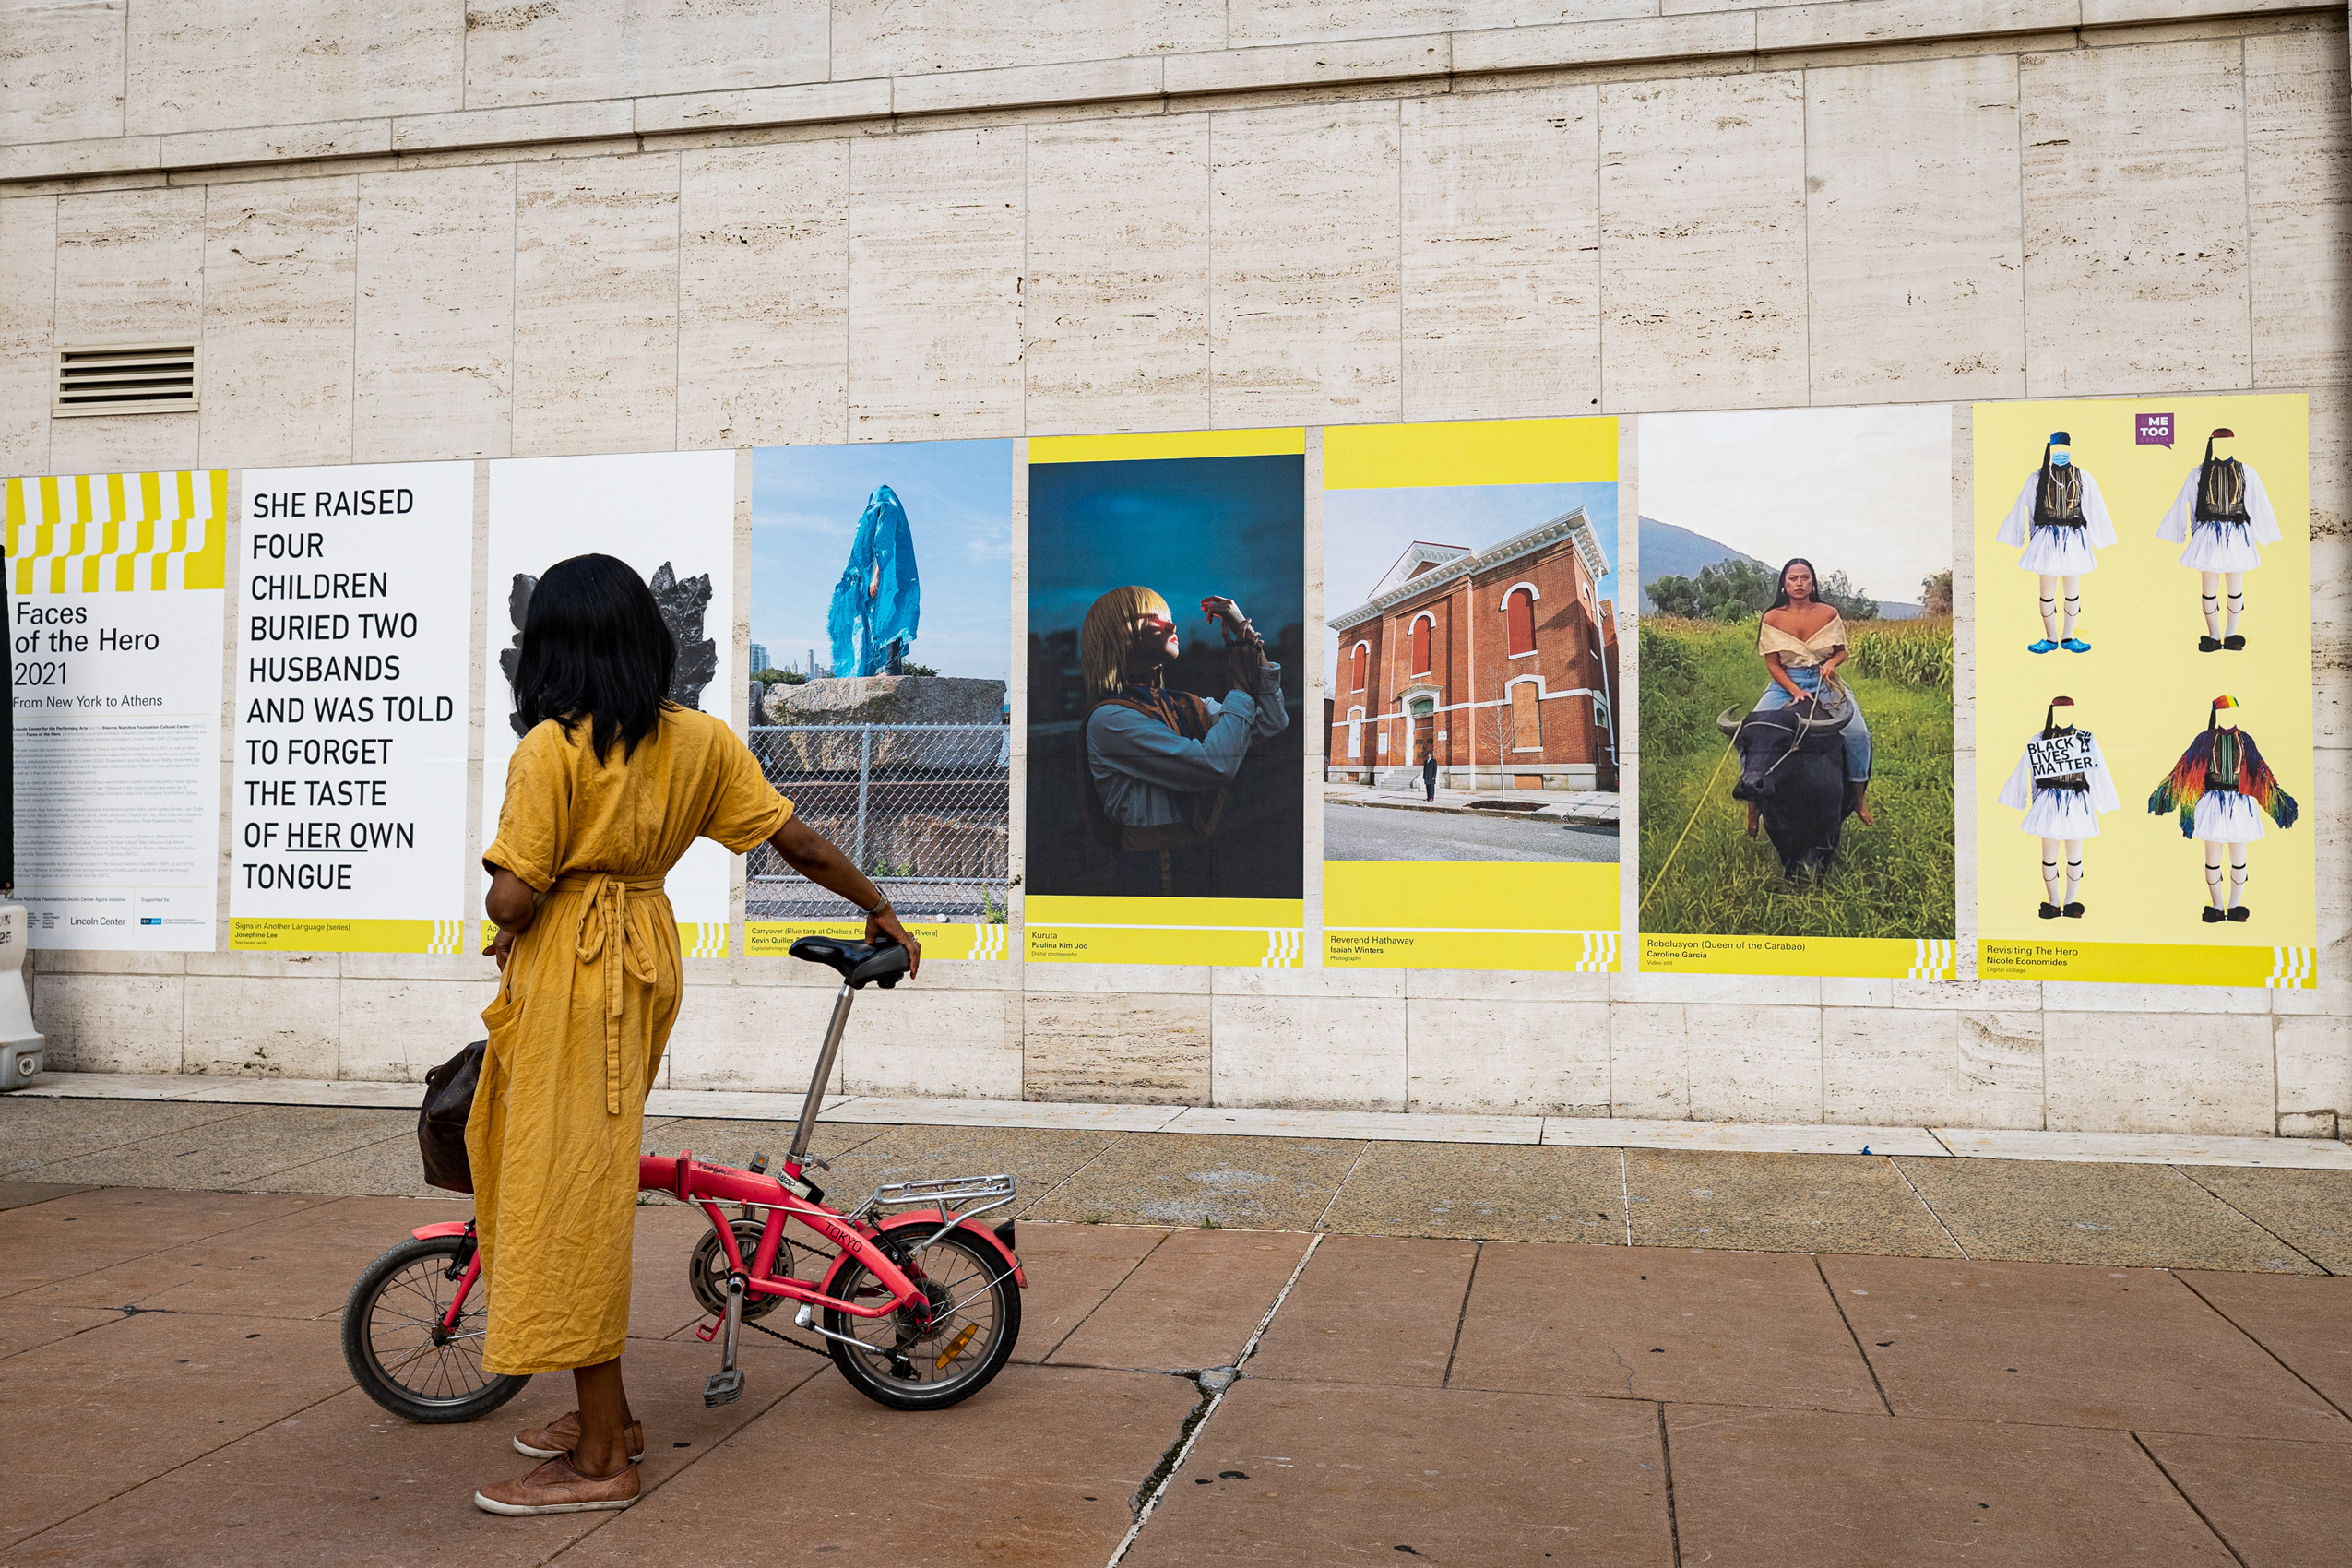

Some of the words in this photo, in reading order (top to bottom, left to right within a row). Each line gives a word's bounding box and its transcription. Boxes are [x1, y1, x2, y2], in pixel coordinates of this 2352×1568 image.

[2140, 427, 2168, 436] TOO
[254, 493, 306, 518] SHE
[316, 489, 412, 517] RAISED
[254, 533, 323, 559] FOUR
[252, 572, 386, 600] CHILDREN
[18, 602, 87, 624] Faces
[251, 615, 349, 641] BURIED
[358, 613, 417, 638] TWO
[16, 630, 40, 653] of
[49, 629, 88, 652] the
[100, 628, 159, 651] Hero
[15, 662, 65, 685] 2021
[250, 655, 399, 682] HUSBANDS
[13, 697, 42, 708] From
[47, 696, 73, 707] New
[77, 695, 101, 707] York
[106, 697, 117, 707] to
[121, 695, 162, 706] Athens
[247, 698, 303, 723] AND
[314, 697, 373, 722] WAS
[383, 696, 453, 722] TOLD
[246, 740, 278, 765] TO
[289, 739, 393, 764] FORGET
[2027, 737, 2074, 754] BLACK
[2030, 750, 2070, 765] LIVES
[2033, 757, 2098, 776] MATTER.
[245, 781, 296, 805] THE
[304, 780, 386, 806] TASTE
[245, 823, 279, 848] OF
[287, 823, 341, 848] HER
[350, 823, 413, 848] OWN
[243, 864, 351, 889] TONGUE
[70, 917, 98, 925] Lincoln
[100, 917, 125, 925] Center
[236, 922, 254, 931] Signs
[292, 923, 325, 932] Language
[803, 929, 817, 937] tarp
[1372, 936, 1414, 945] Hathaway
[1647, 939, 1699, 950] Rebolusyon
[1702, 941, 1733, 949] (Queen
[1764, 942, 1805, 951] Carabao)
[1987, 945, 2032, 956] Revisiting
[2056, 947, 2078, 956] Hero
[2016, 957, 2067, 966] Economides
[824, 1221, 862, 1253] TOKYO
